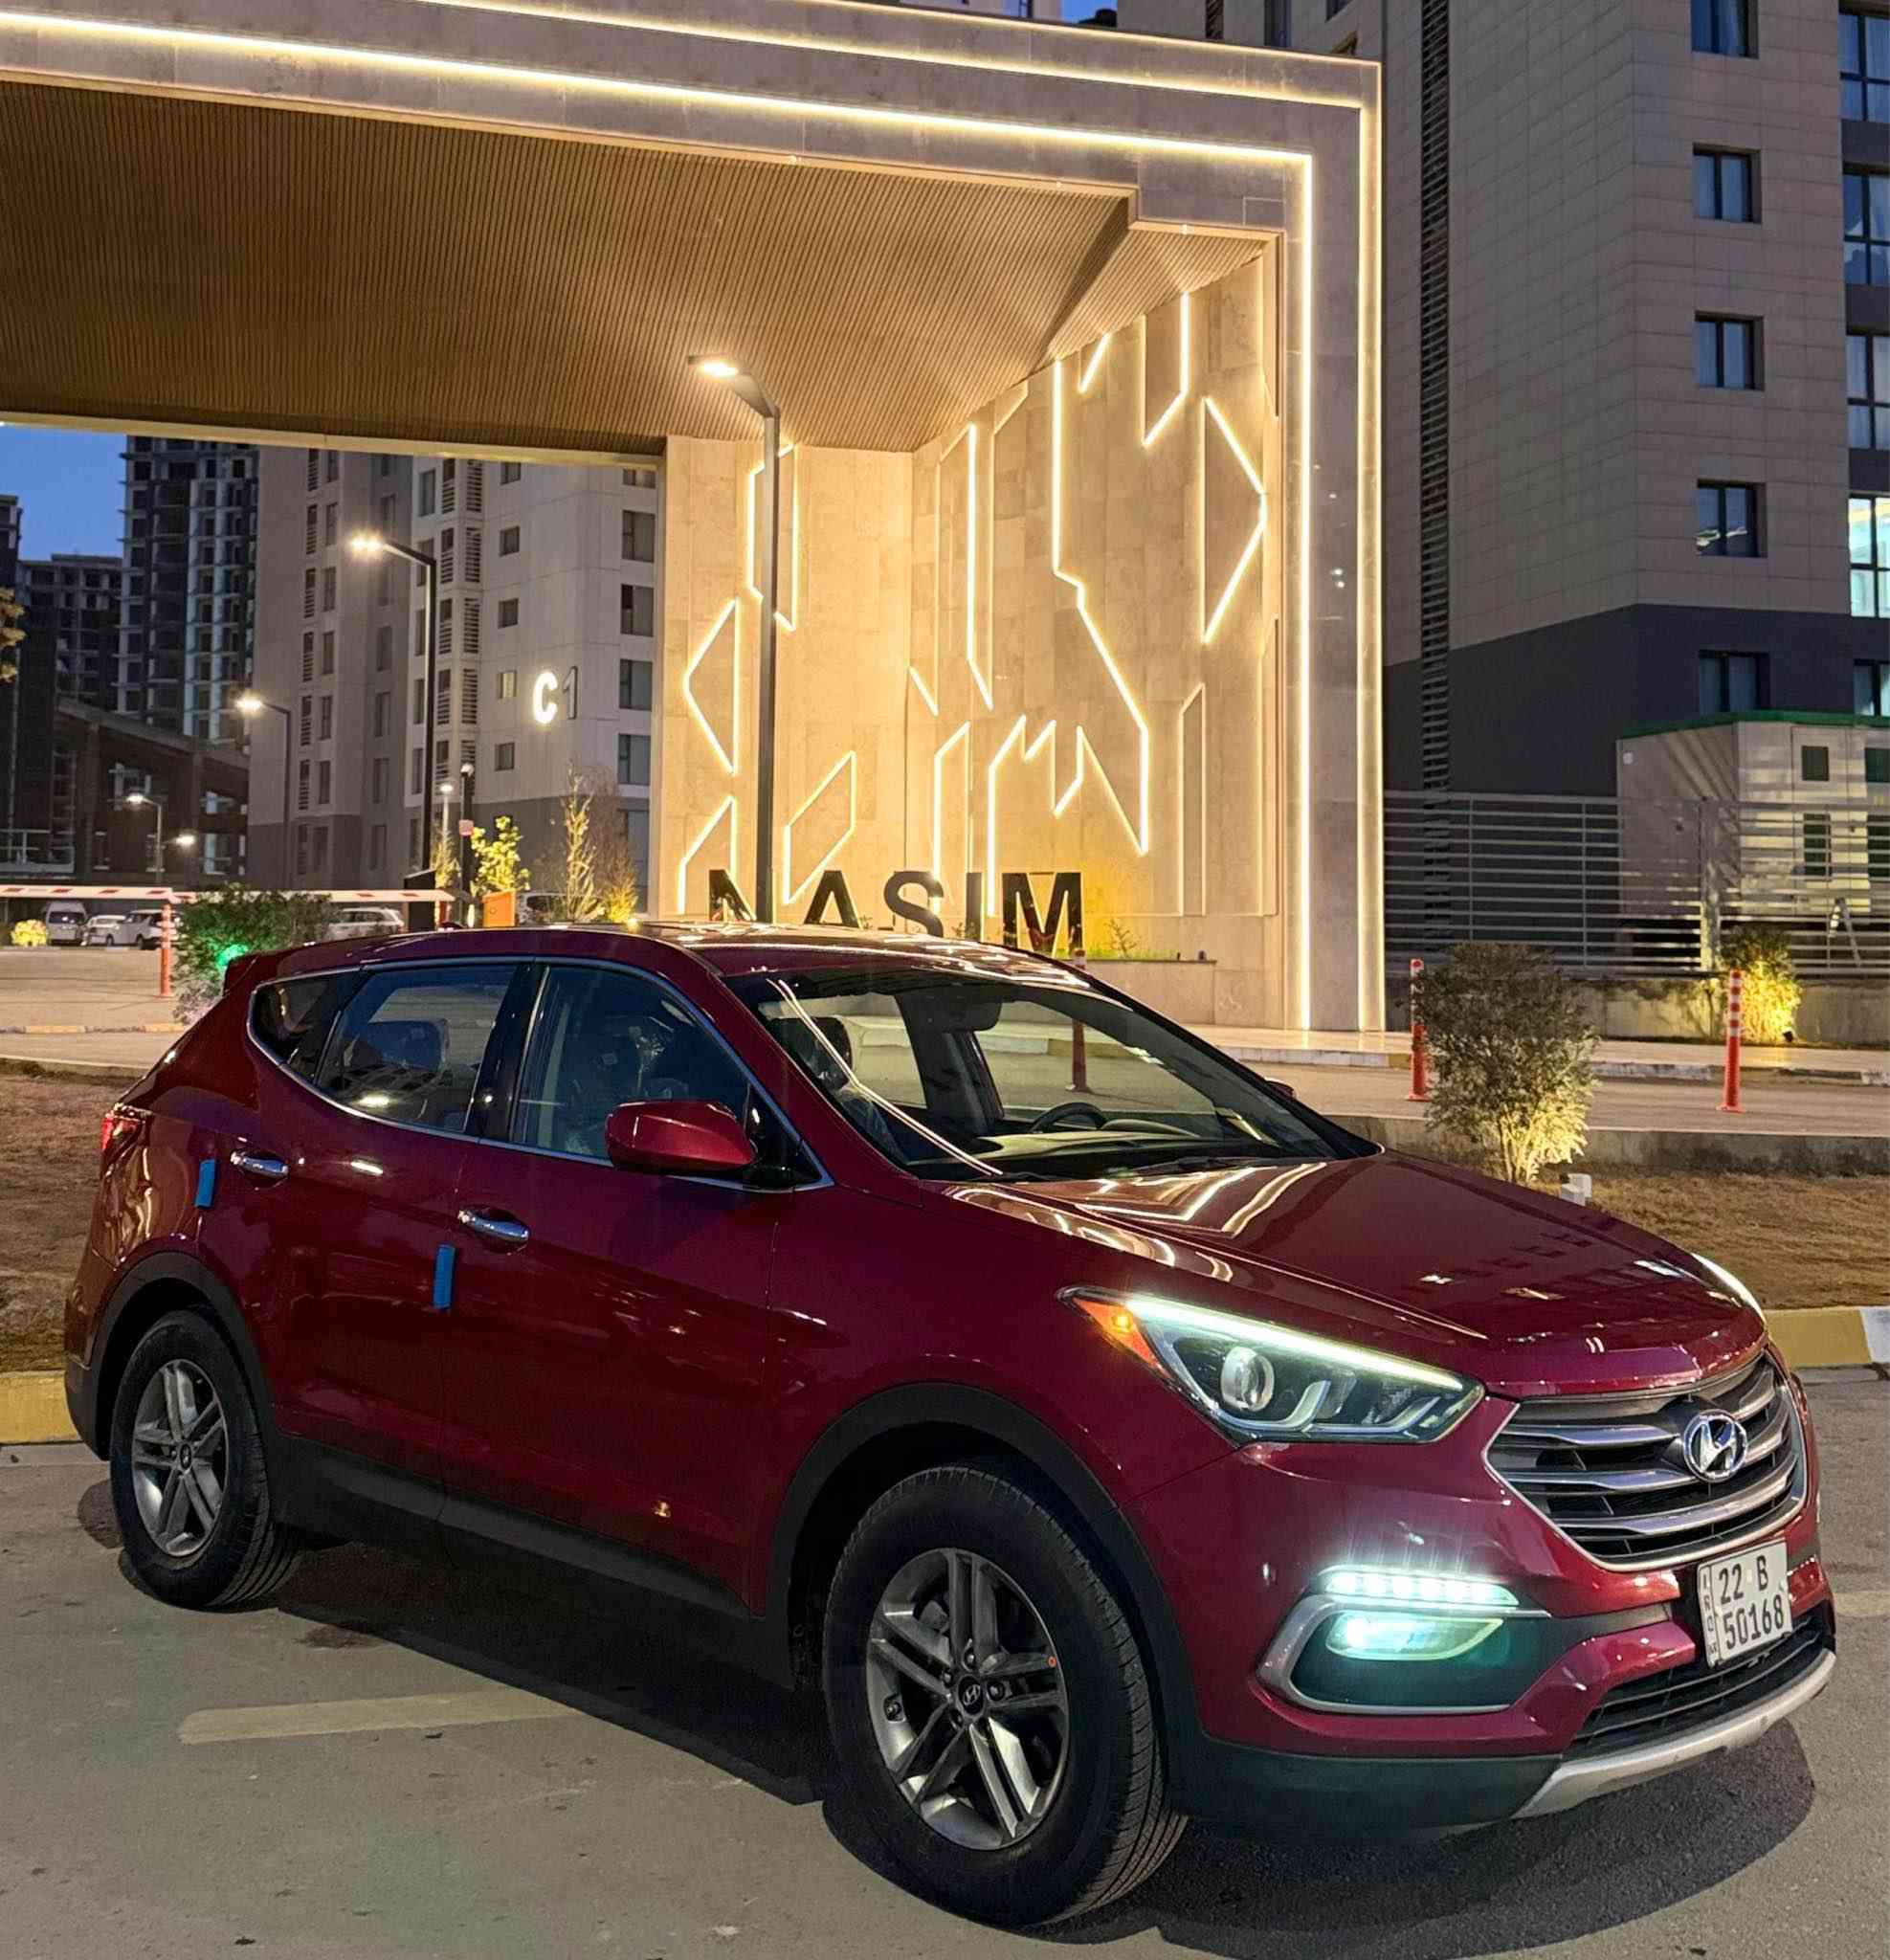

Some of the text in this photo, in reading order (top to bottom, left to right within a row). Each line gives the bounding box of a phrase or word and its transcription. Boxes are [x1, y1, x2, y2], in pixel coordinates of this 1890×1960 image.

[533, 666, 578, 724] C1
[1719, 1555, 1768, 1605] 22 B
[1723, 1594, 1784, 1650] 50168
